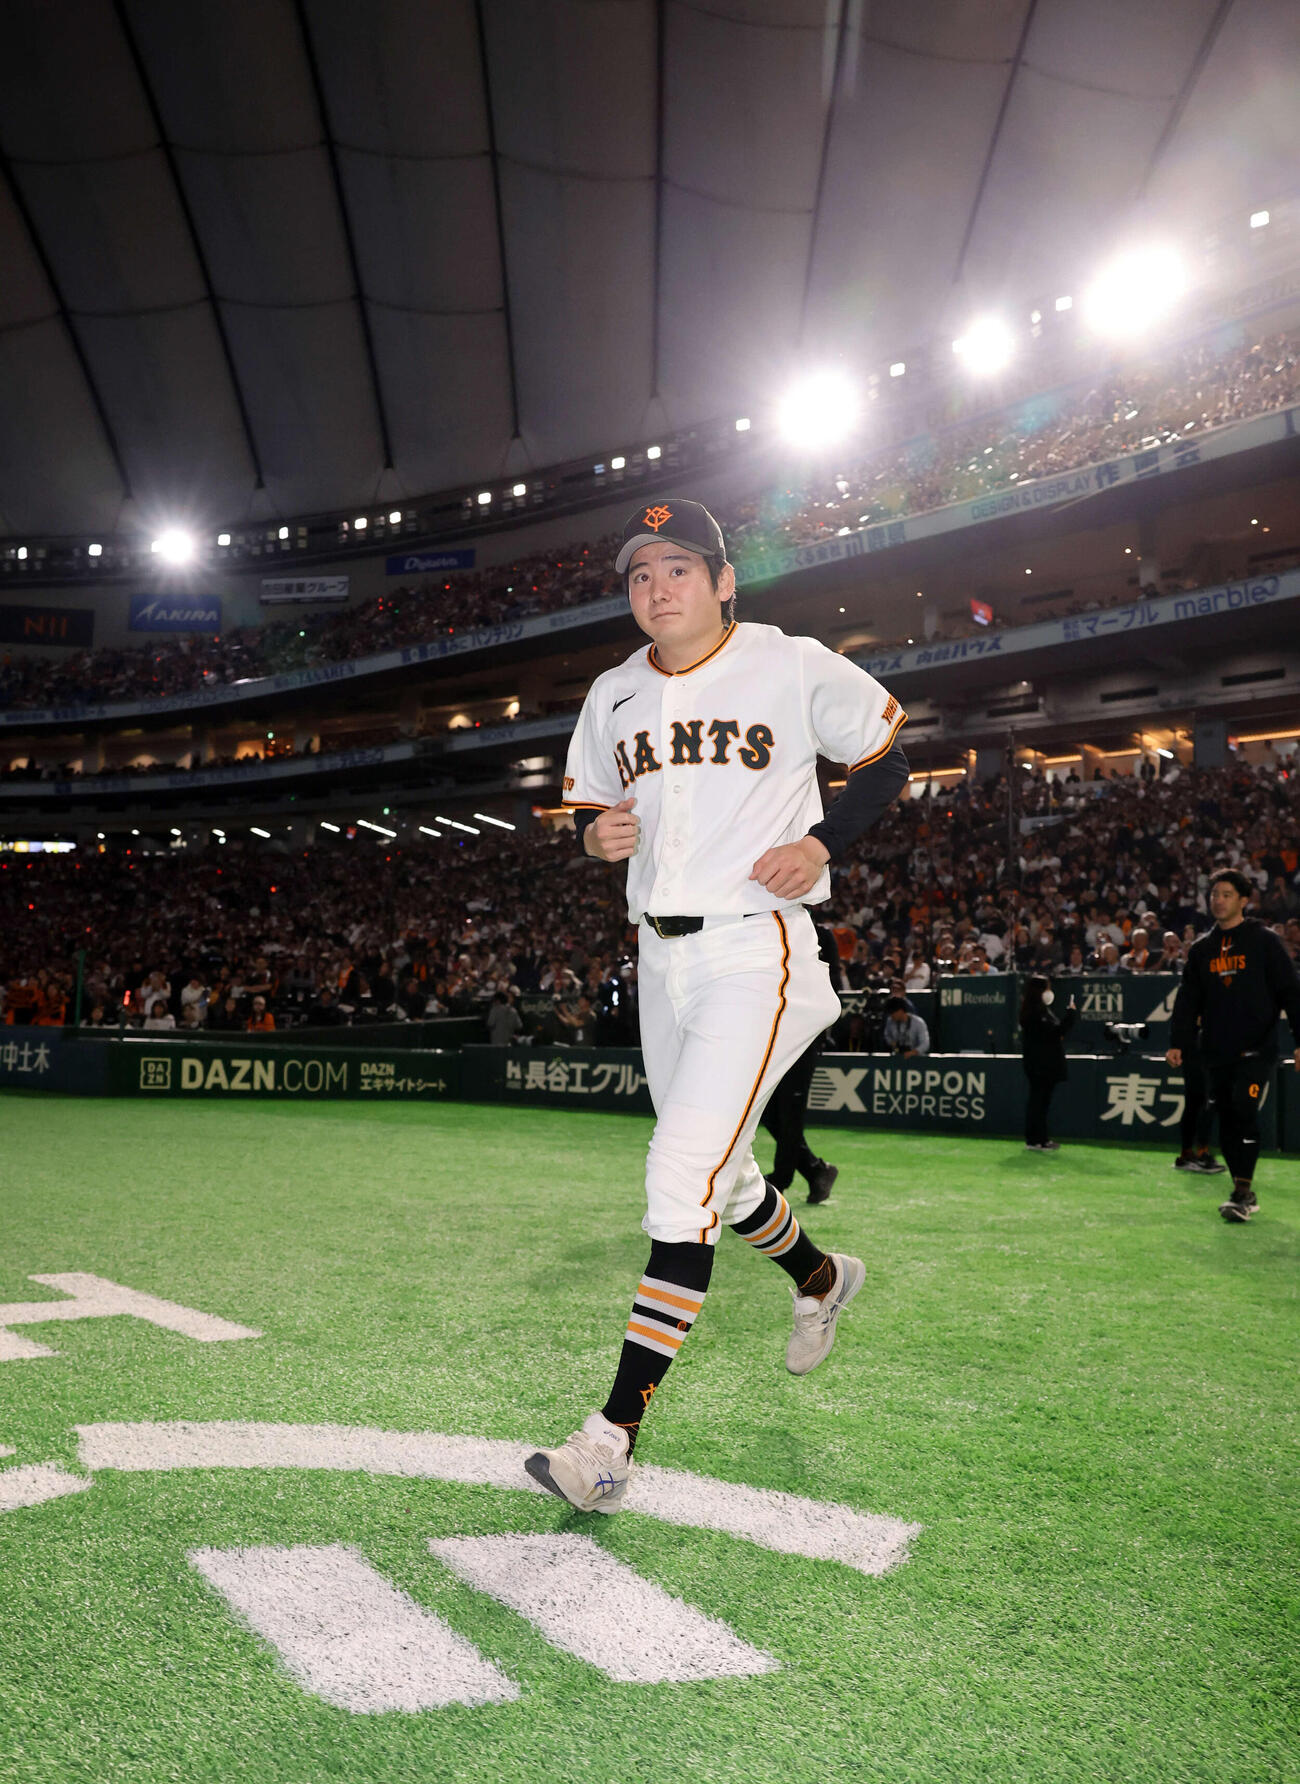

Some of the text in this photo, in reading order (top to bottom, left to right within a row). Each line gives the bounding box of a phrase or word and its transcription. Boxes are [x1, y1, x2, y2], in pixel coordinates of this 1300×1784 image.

[1174, 582, 1268, 619] marble
[154, 609, 218, 621] AKIRA
[1081, 994, 1123, 1012] ZEN
[0, 1041, 50, 1074] 中土木
[360, 1062, 395, 1076] DAZN
[181, 1058, 348, 1091] DAZN.COM
[360, 1078, 447, 1092] エキサイトシート
[873, 1069, 985, 1095] NIPPON
[873, 1093, 985, 1120] EXPRESS
